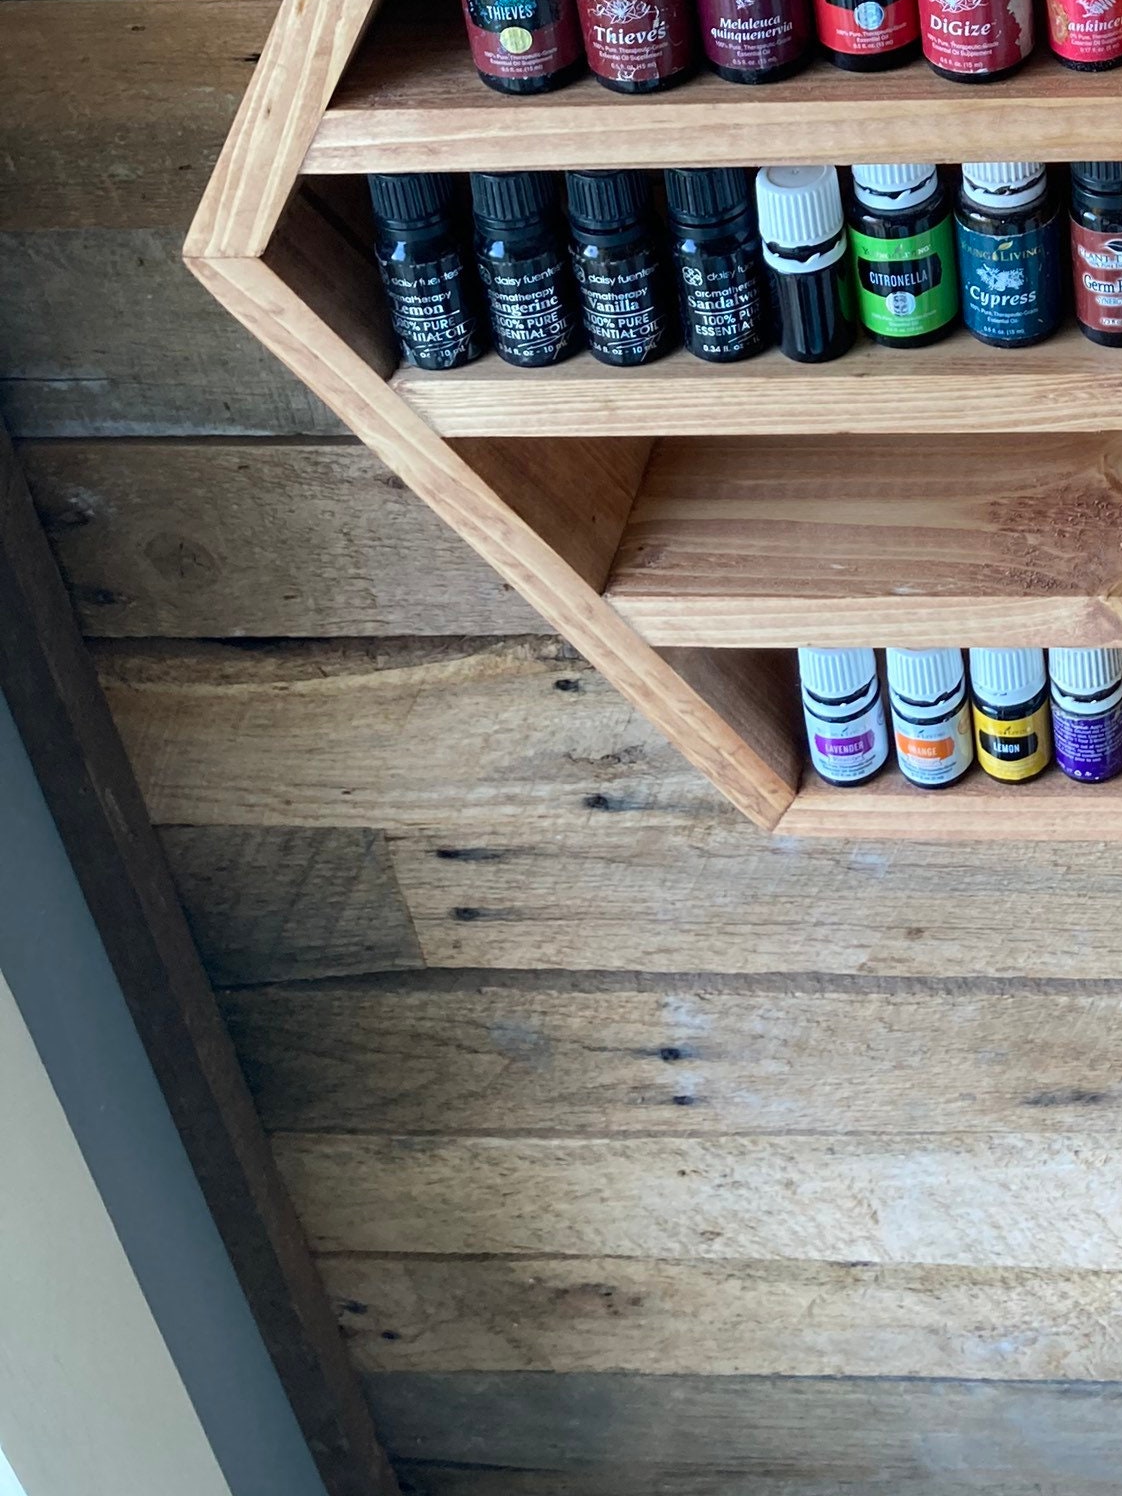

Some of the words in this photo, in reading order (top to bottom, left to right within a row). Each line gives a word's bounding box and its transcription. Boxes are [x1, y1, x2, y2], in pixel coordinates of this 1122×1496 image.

[486, 4, 533, 20] THIEVES
[719, 15, 781, 30] Melaleuca
[930, 14, 991, 36] DiGize
[593, 24, 667, 45] Thieves
[710, 21, 793, 43] quinquenervia
[1000, 246, 1041, 261] LIVING
[1080, 247, 1109, 263] PLANT
[494, 275, 521, 287] daisy
[523, 265, 560, 284] fuentes
[588, 274, 616, 286] daisy
[869, 269, 928, 287] CITRONELLA
[1083, 274, 1115, 293] Germ
[588, 296, 639, 313] Vanilla
[970, 285, 1037, 308] Cypress
[423, 317, 456, 331] PURE
[527, 311, 558, 329] PURE
[587, 312, 616, 328] 100%
[618, 313, 650, 328] PURE
[695, 319, 754, 336] ESSENTIAL
[702, 314, 736, 326] 100%
[446, 323, 467, 339] OIL
[543, 345, 554, 353] 10
[632, 346, 643, 354] 10
[703, 345, 721, 353] 0.34
[825, 741, 864, 754] LAVENDER
[993, 742, 1020, 754] LEMON
